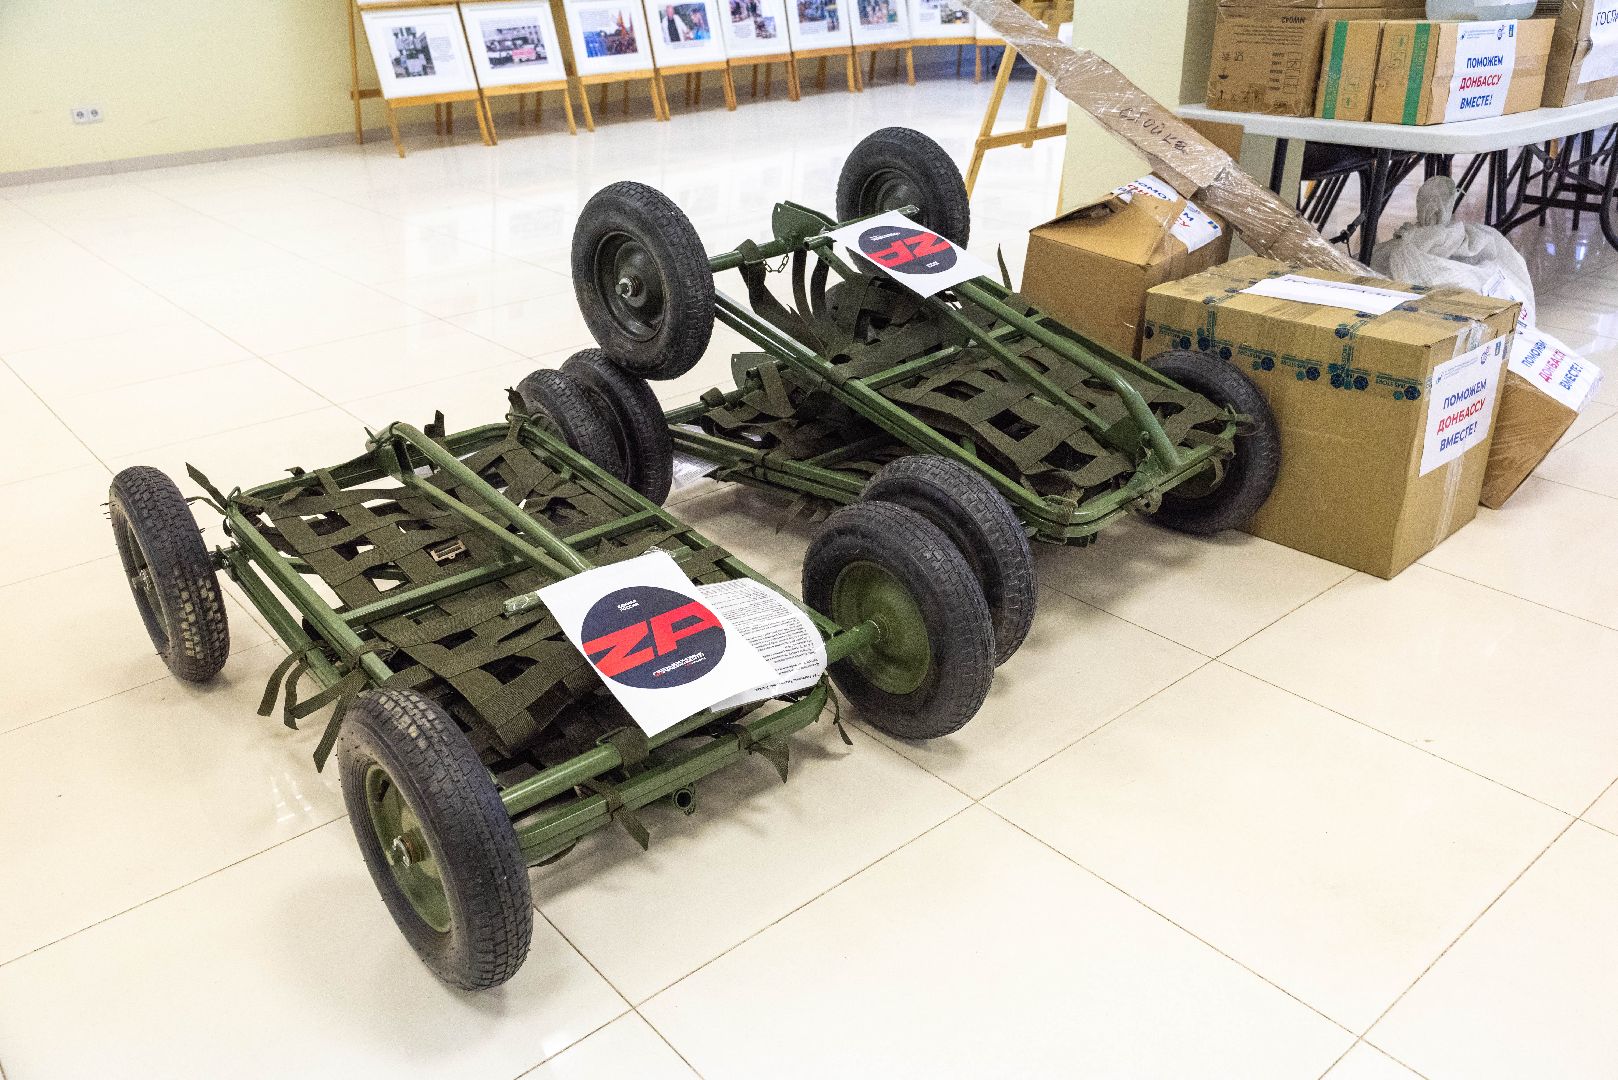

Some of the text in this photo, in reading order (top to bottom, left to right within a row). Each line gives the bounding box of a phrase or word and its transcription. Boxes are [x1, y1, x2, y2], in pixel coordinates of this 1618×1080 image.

[1466, 54, 1504, 69] ПОМОЖЕМ
[1458, 74, 1503, 91] ДОНБАССУ
[1460, 94, 1493, 109] ВМЕСТЕ!
[1443, 379, 1487, 409] ПОМОЖЕМ
[1436, 397, 1486, 435] ДОНБАССУ
[1439, 420, 1478, 452] ВМЕСТЕ!
